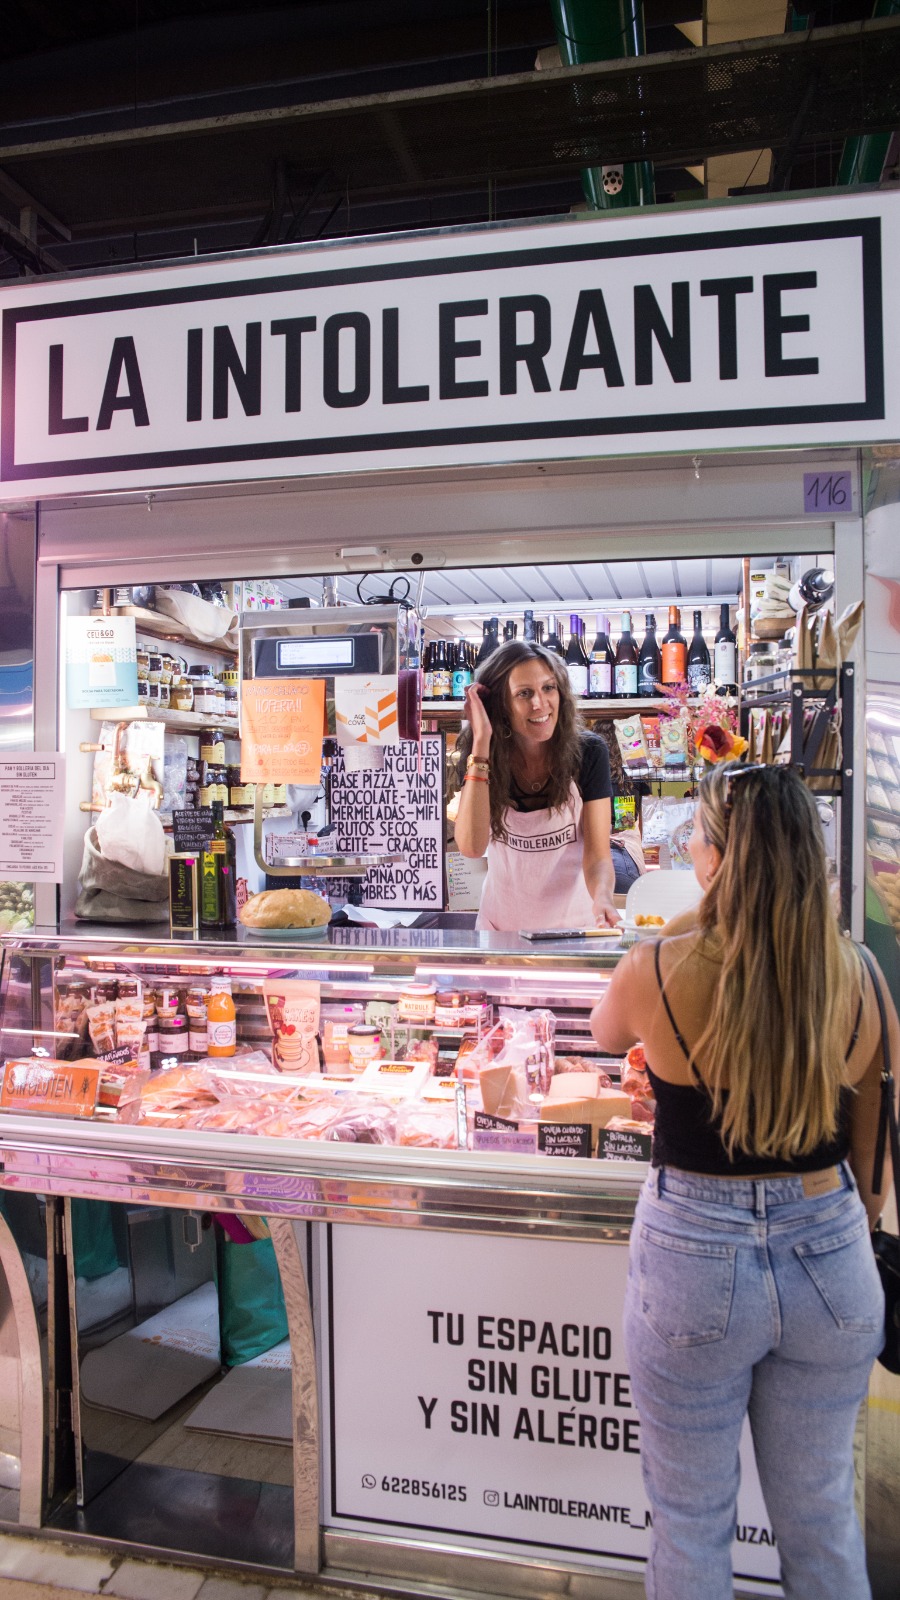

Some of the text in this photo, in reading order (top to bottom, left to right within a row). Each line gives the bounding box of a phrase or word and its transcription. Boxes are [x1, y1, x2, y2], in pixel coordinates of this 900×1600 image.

[47, 270, 820, 435] LA INTOLERANTE
[807, 475, 846, 507] 116
[86, 630, 115, 639] CELI&GO
[396, 757, 440, 772] GLUEN
[332, 774, 358, 788] BASE
[363, 774, 396, 788] PIZZA
[406, 773, 436, 788] VINO
[332, 790, 399, 805] CHOCOLATE
[406, 789, 438, 804] TAHIN
[332, 805, 406, 820] MERMELADAS
[380, 821, 418, 836] SECOS
[387, 837, 438, 852] CRACKER
[509, 829, 571, 849] INTOLERANTE
[409, 853, 438, 868] GHEE
[363, 869, 420, 884] APINADOS
[361, 884, 397, 900] MBRES
[401, 885, 409, 900] Y
[413, 881, 437, 900] MÁS
[545, 1135, 556, 1144] SIN
[603, 1140, 616, 1151] SIN
[427, 1310, 612, 1361] TU ESPACIO
[468, 1358, 633, 1408] SIN GLUTE
[417, 1395, 641, 1455] Y SIN ALÉRGE
[381, 1475, 468, 1502] 622856125
[503, 1491, 654, 1531] LAINTOLERANTE_M
